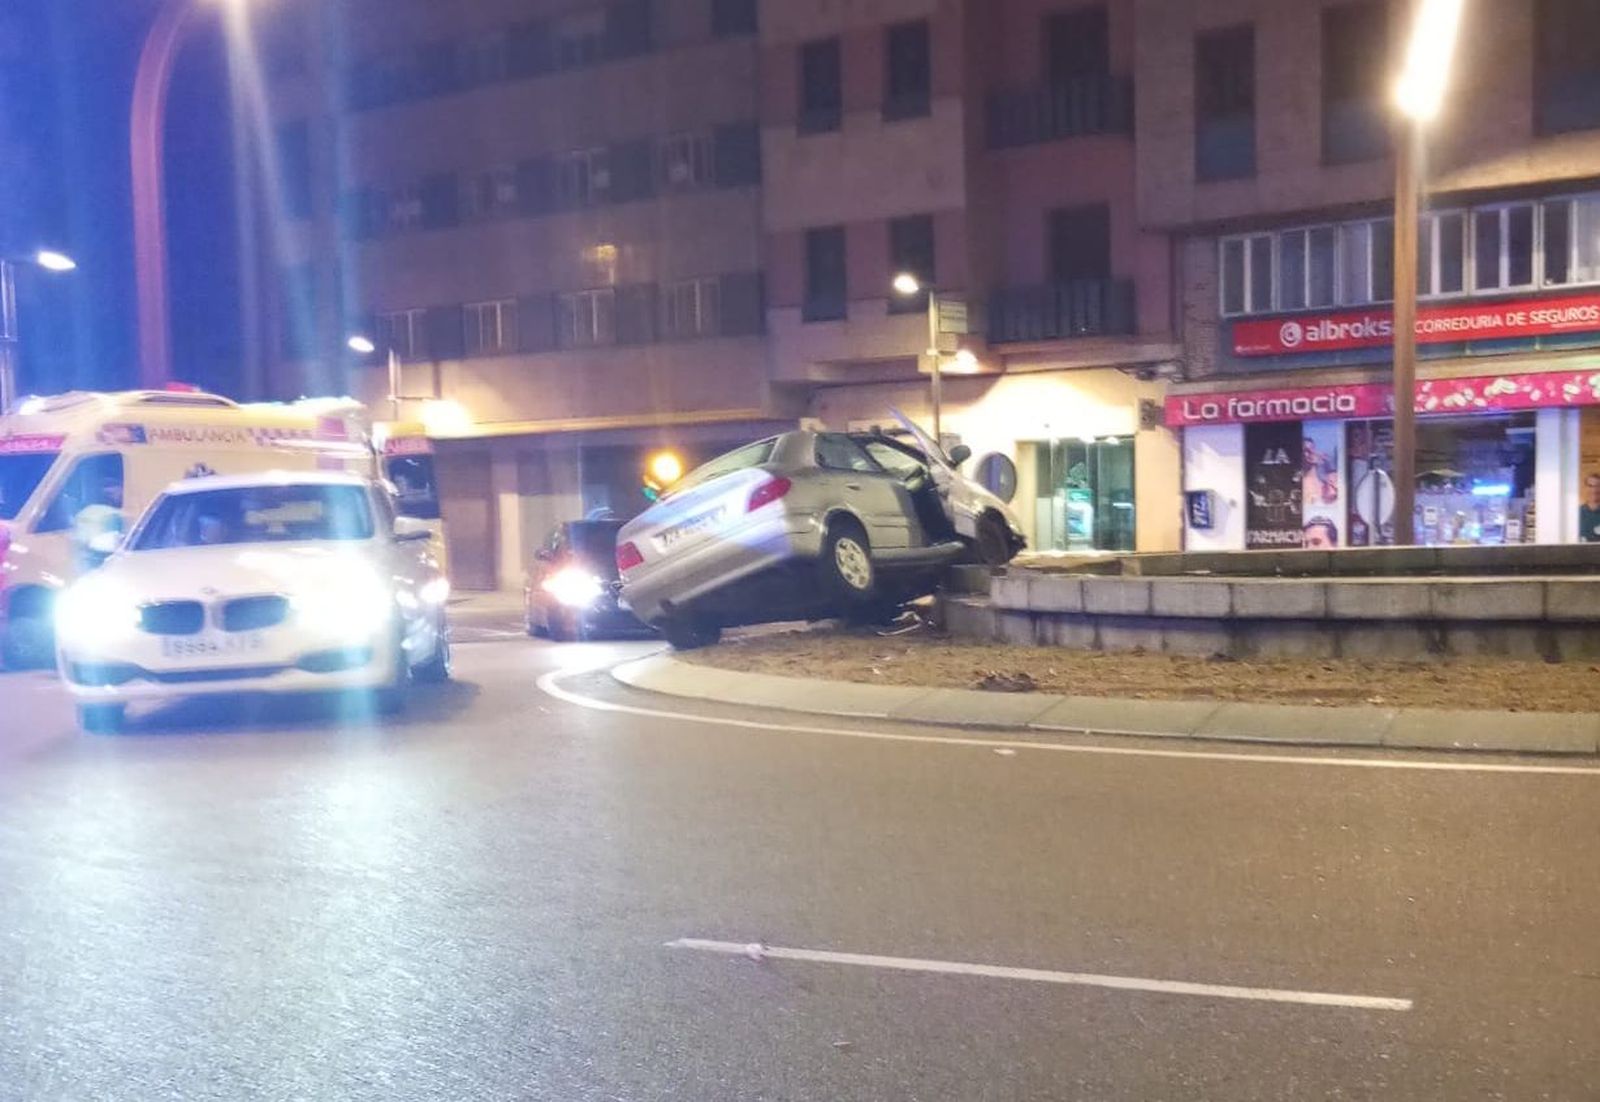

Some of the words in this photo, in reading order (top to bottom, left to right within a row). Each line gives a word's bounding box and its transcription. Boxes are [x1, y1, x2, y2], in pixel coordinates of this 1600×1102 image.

[1414, 314, 1503, 334] CORREDURIA
[1505, 312, 1528, 326] DE
[1529, 305, 1600, 325] SEGUROS
[1183, 402, 1219, 419] La
[1227, 392, 1356, 418] farmacia
[149, 427, 248, 443] AMBULANCIA
[1261, 448, 1291, 464] LA
